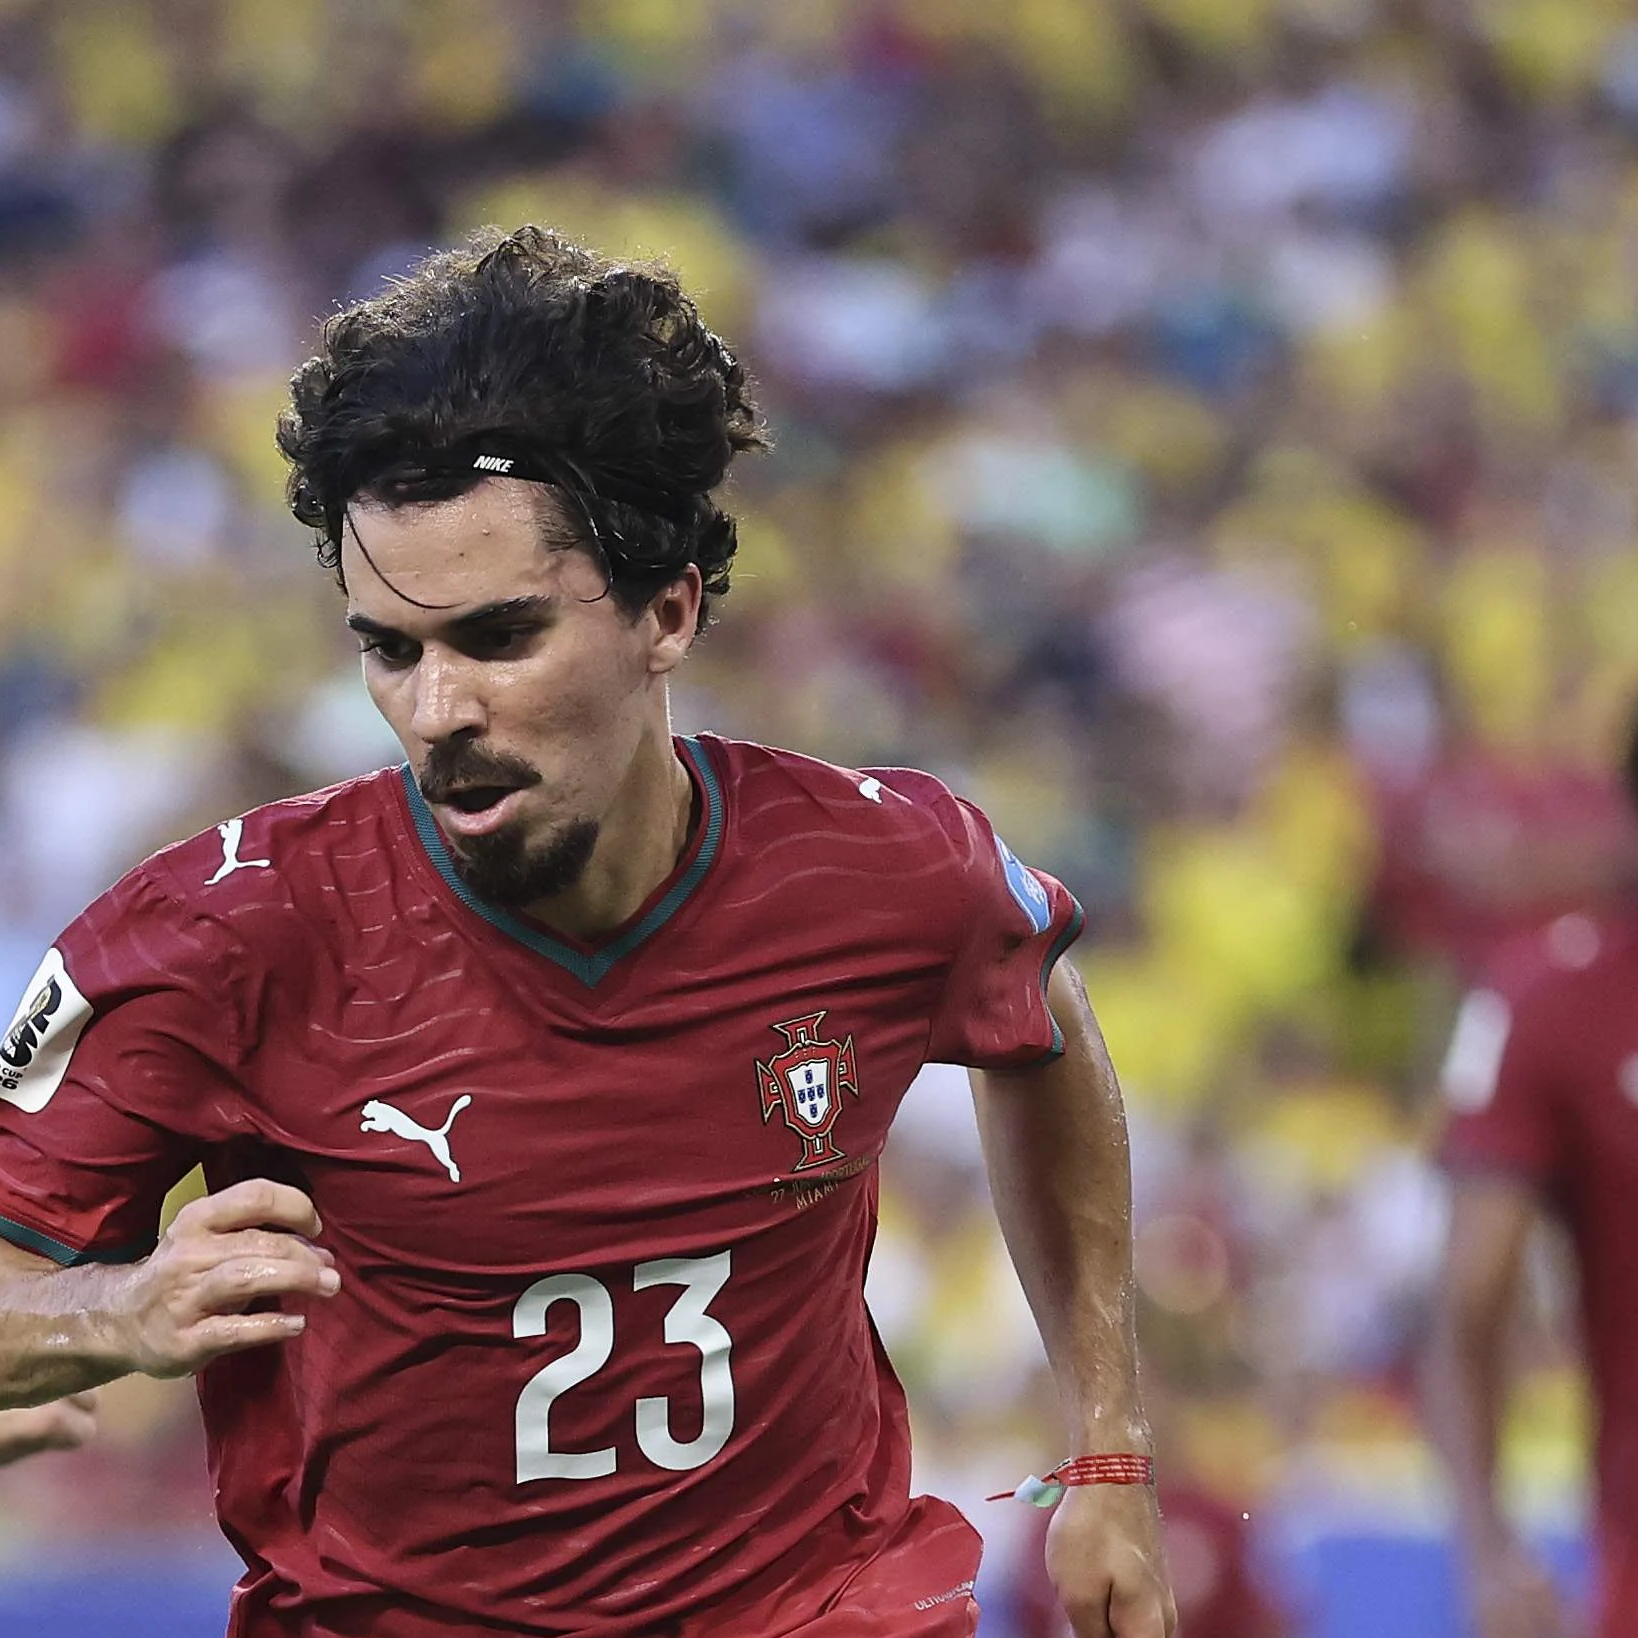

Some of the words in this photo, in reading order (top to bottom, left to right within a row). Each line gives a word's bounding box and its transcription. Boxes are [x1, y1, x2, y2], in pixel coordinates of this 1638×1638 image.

[473, 455, 514, 473] NIKE
[2, 1067, 24, 1079] CUP
[513, 1249, 735, 1484] 23
